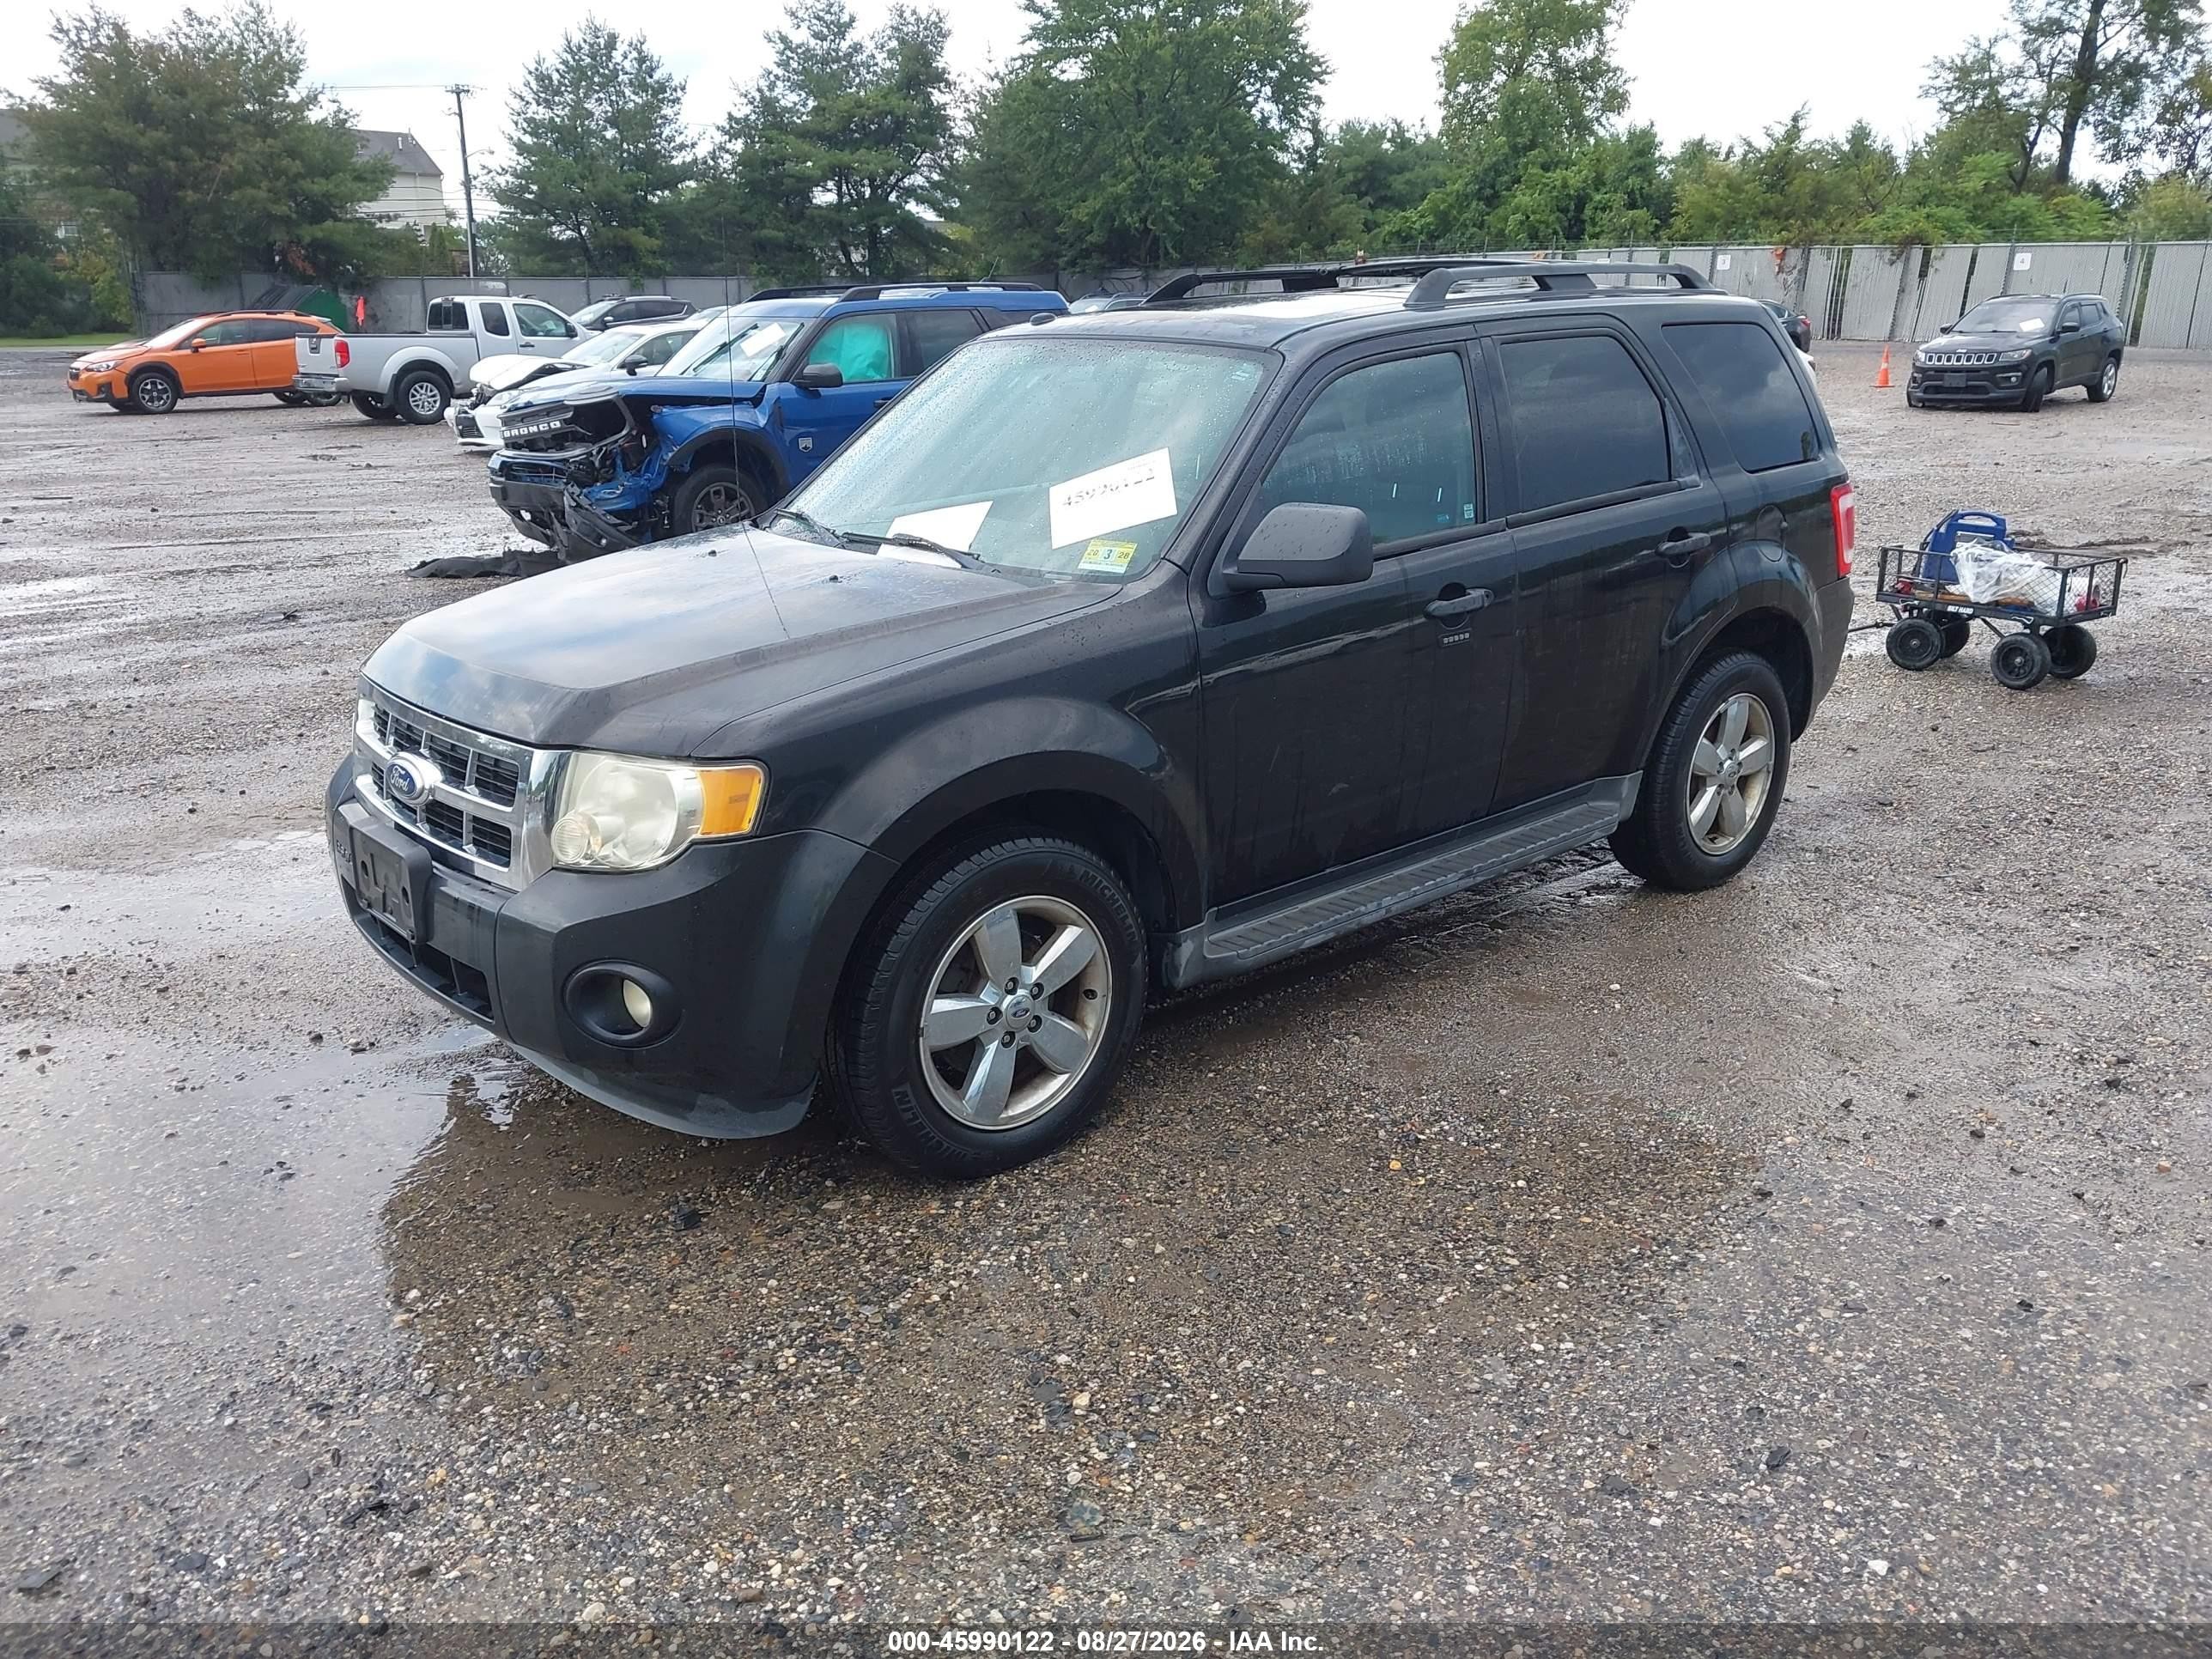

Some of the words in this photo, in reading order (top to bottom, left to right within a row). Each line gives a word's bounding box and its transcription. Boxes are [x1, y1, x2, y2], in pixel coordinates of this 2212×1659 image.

[502, 420, 562, 438] BRONCO
[1103, 549, 1113, 559] 3
[390, 765, 410, 792] Ford
